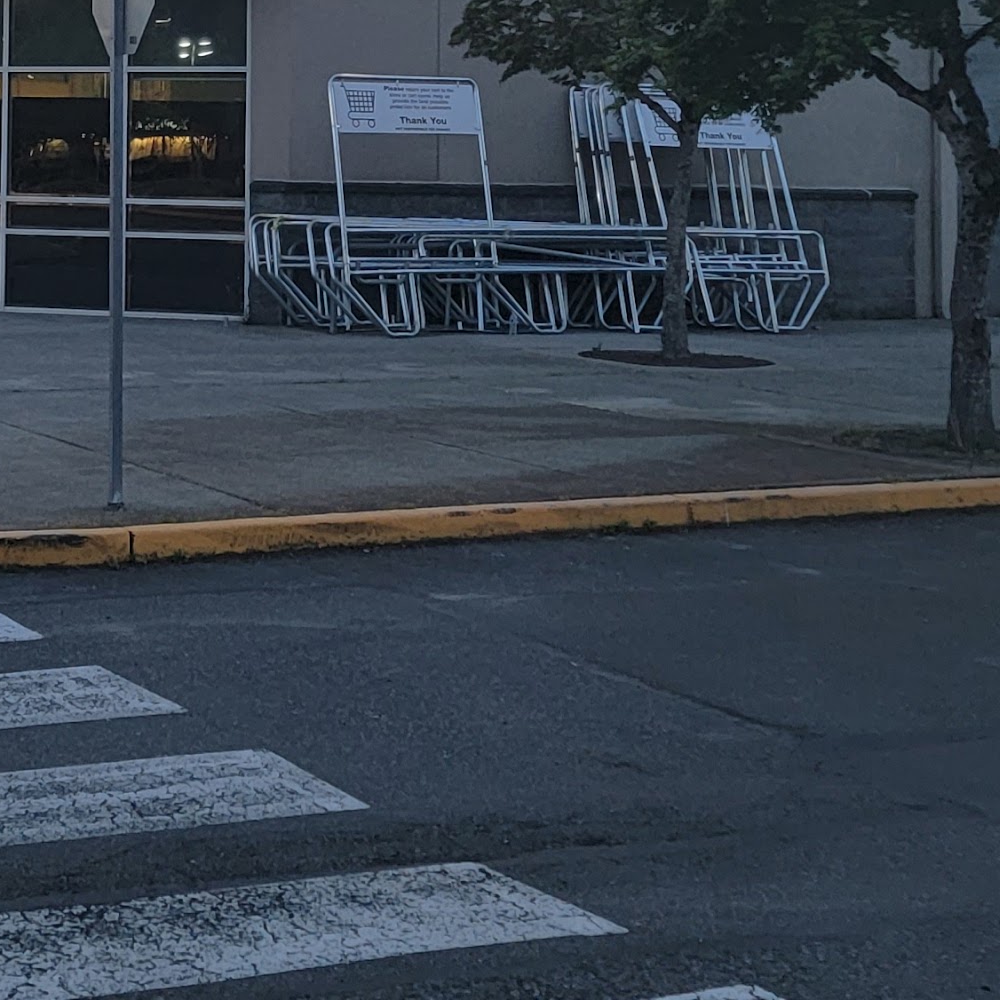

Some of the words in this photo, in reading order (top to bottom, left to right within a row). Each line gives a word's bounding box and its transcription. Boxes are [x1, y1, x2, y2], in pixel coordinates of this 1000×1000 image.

[399, 116, 428, 125] Thank
[430, 116, 447, 125] You
[700, 131, 724, 139] Thank
[726, 132, 742, 140] You
